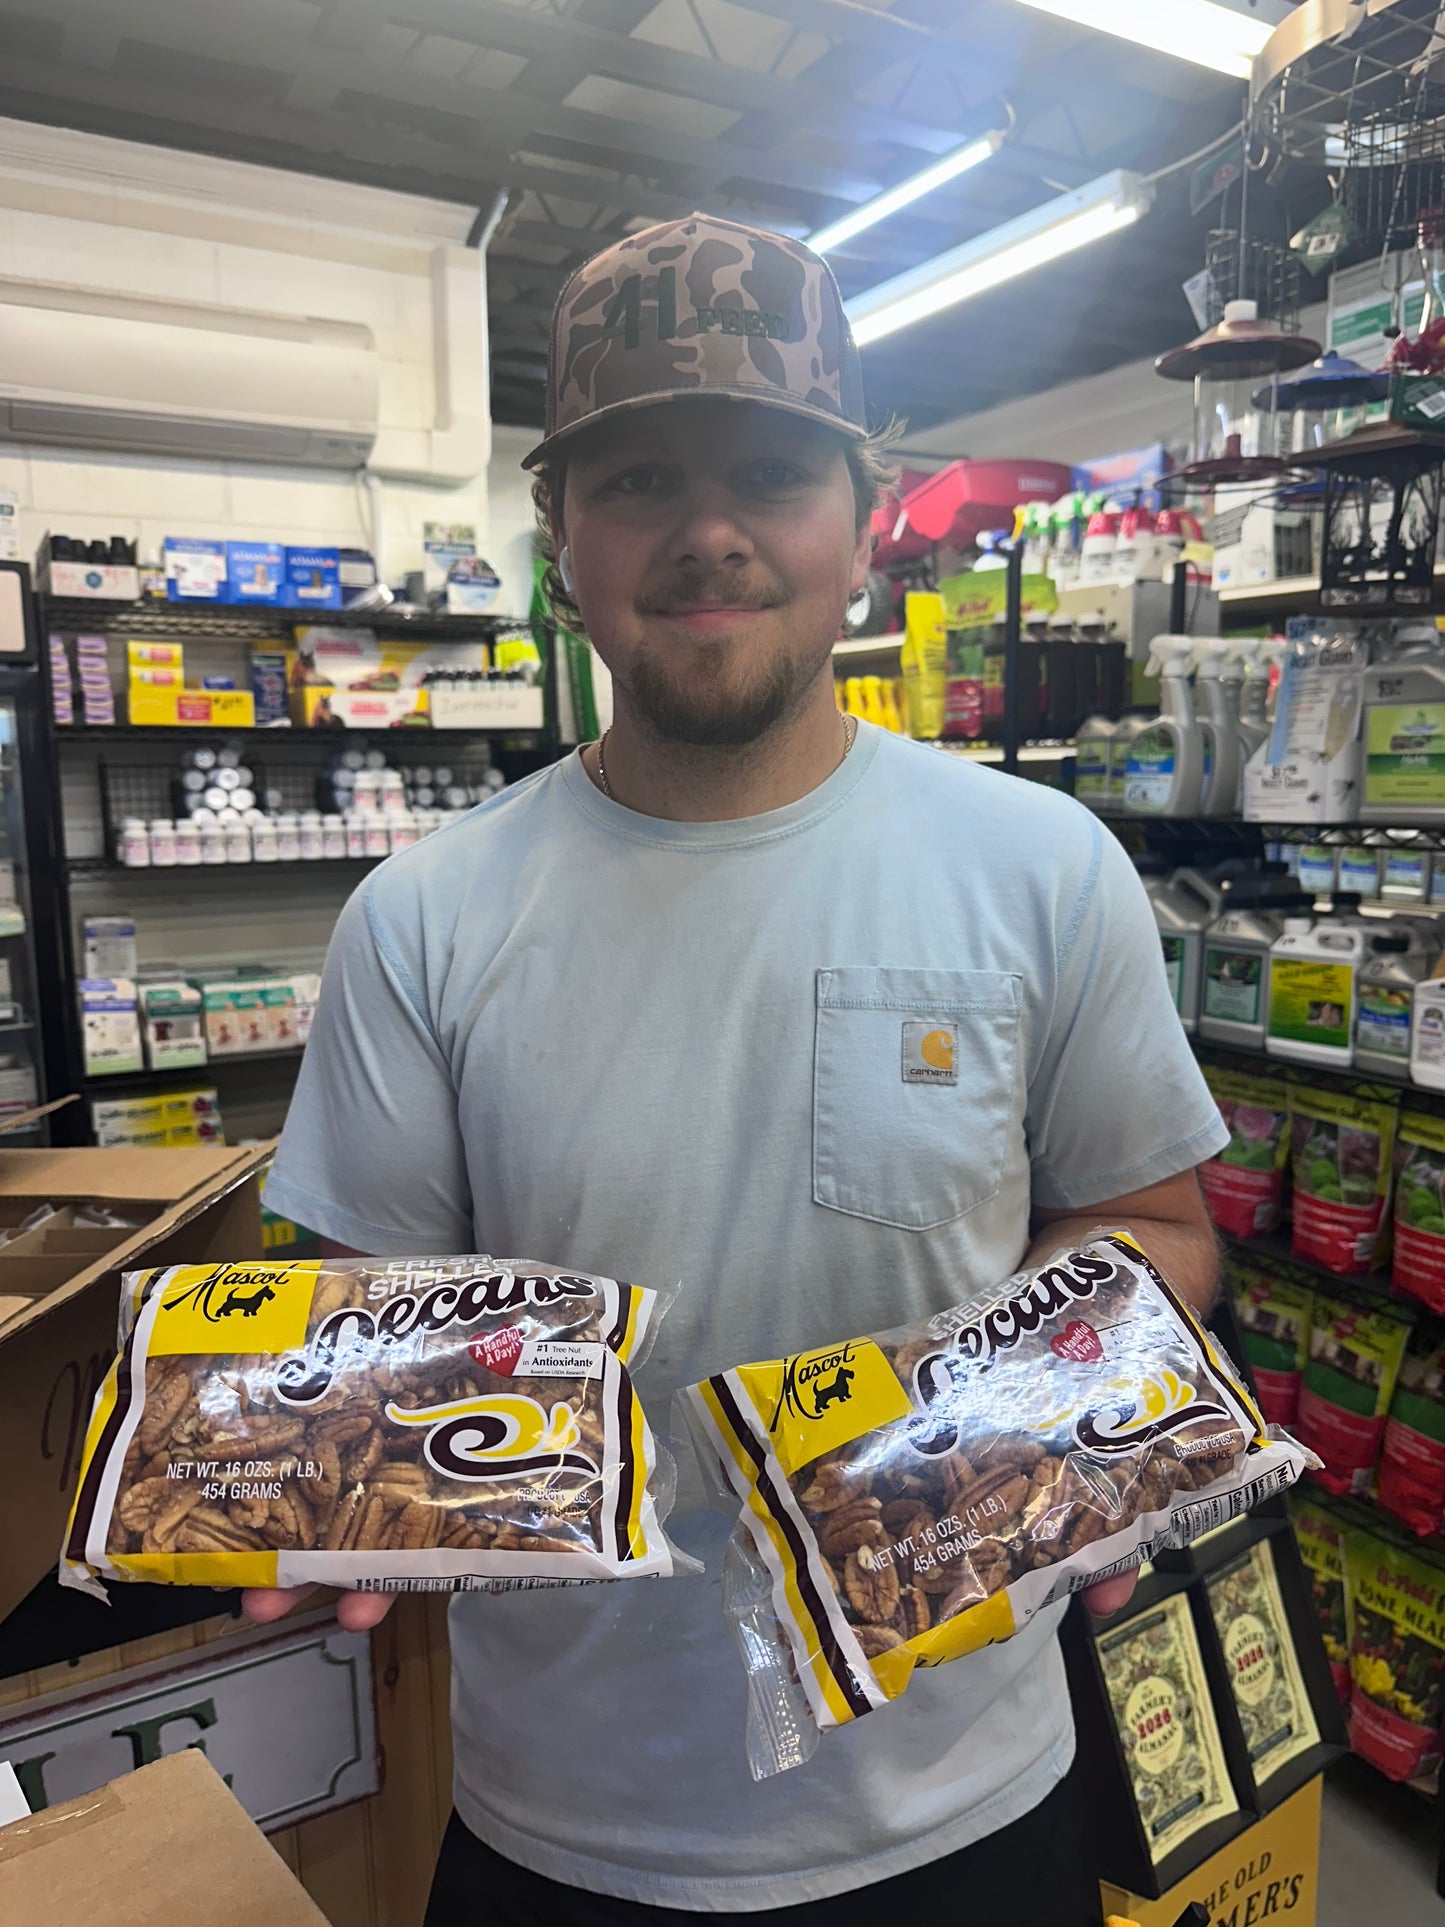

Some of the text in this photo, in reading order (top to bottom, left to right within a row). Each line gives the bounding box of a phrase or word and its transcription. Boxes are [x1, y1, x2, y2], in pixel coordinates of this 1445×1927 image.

[910, 1068, 953, 1077] carhartt
[386, 1255, 492, 1273] FRESH
[162, 1262, 299, 1322] Mascot
[273, 1273, 597, 1406] Pecans
[475, 1326, 520, 1359] A Handful
[536, 1344, 549, 1353] #1
[568, 1346, 582, 1354] Nut
[1058, 1322, 1091, 1357] A Handful
[1072, 1336, 1096, 1361] A Day!
[486, 1343, 517, 1366] A Day!
[531, 1357, 593, 1368] Antioxidants
[906, 1250, 1117, 1460] Pecans
[769, 1340, 872, 1433] Mascot
[1174, 1437, 1210, 1457] PRODUCT
[1220, 1432, 1236, 1446] USA
[166, 1461, 324, 1481] NET WT. 16 OZS. (1 LB.)
[201, 1482, 282, 1500] 454 GRAMS
[871, 1494, 1008, 1572] NET WT. 16 OZS. (1 LB.)
[913, 1528, 984, 1574] 454 GRAMS
[1202, 1851, 1272, 1912] HE OLD
